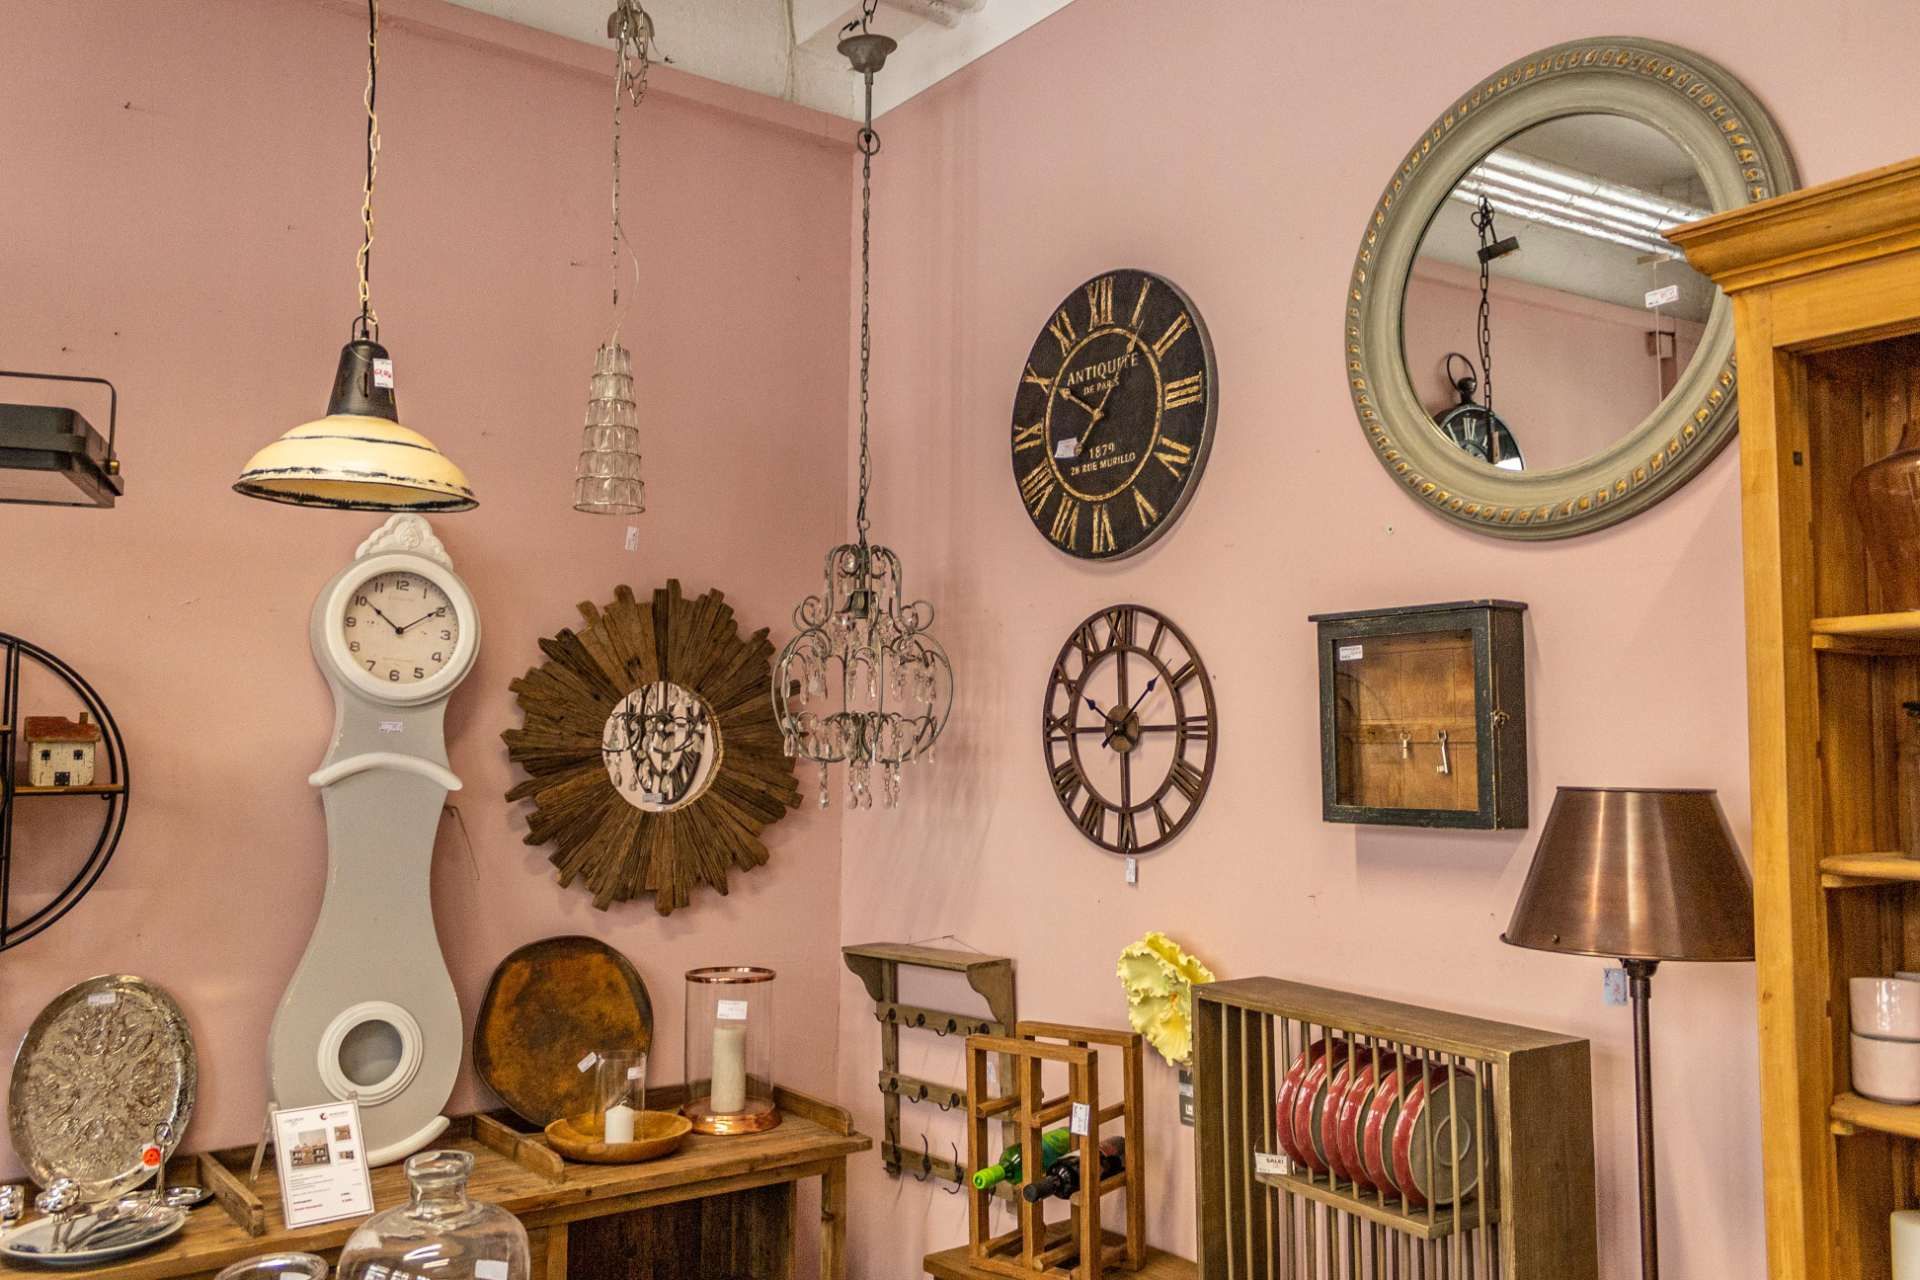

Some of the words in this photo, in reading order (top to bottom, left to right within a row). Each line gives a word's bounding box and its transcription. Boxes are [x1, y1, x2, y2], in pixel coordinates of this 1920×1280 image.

[1085, 276, 1115, 332] XII
[1129, 276, 1151, 328] I
[1049, 306, 1076, 357] XI
[1152, 311, 1191, 361] II
[1022, 362, 1053, 394] X
[1164, 371, 1203, 410] III
[1013, 418, 1044, 453] IX
[1089, 442, 1116, 459] 1879
[1153, 435, 1193, 482] IV
[1082, 461, 1098, 473] RUE
[1099, 451, 1137, 470] MURILLO
[1020, 457, 1057, 520] VIII
[1132, 486, 1160, 529] V
[1051, 492, 1080, 550] VII
[1092, 503, 1118, 553] VI
[374, 582, 384, 593] 11
[396, 580, 410, 591] 12
[423, 587, 427, 599] 1
[355, 595, 367, 606] 10
[345, 616, 357, 627] 9
[435, 606, 446, 618] 2
[440, 630, 451, 641] 3
[350, 641, 360, 652] 8
[366, 660, 376, 671] 7
[432, 652, 443, 663] 4
[389, 669, 400, 682] 6
[413, 667, 424, 679] 5
